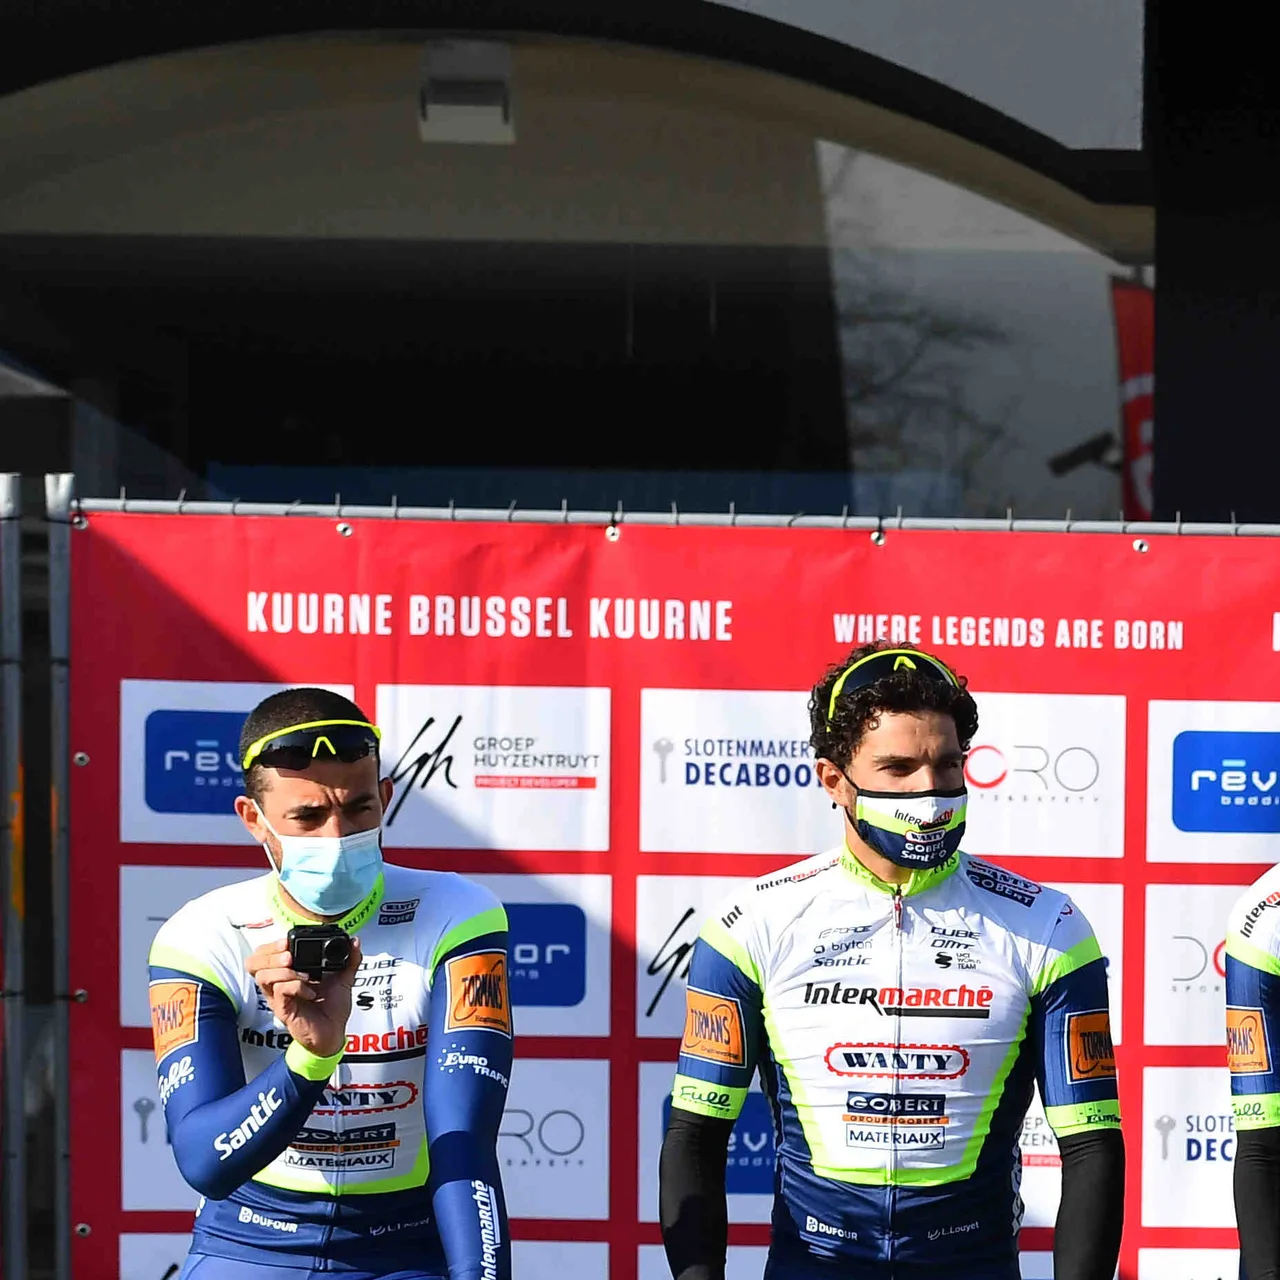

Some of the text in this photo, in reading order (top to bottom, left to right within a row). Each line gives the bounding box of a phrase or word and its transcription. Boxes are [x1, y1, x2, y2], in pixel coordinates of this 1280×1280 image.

[247, 592, 733, 642] KUURNE BRUSSEL KUURNE
[833, 613, 1184, 650] WHERE LEGENDS ARE BORN
[473, 737, 535, 751] GROEP
[685, 738, 810, 758] SLOTENMAKER
[474, 754, 600, 768] HUYZENTRUYT
[685, 761, 820, 787] DECABOO
[968, 873, 1032, 905] GOBERT
[931, 926, 981, 940] CUBE
[832, 939, 873, 952] bryton
[812, 955, 873, 968] Santic
[804, 981, 994, 1016] Intermarché
[690, 1009, 731, 1046] TORMANS
[443, 1052, 489, 1067] EURO
[842, 1052, 953, 1071] WANTY
[848, 1096, 941, 1112] GOBERT
[212, 1087, 283, 1161] Santic
[849, 1129, 942, 1145] MATERIAUX
[287, 1152, 391, 1169] MATERIAUX
[252, 1213, 298, 1234] DUFOUR
[818, 1222, 858, 1241] DUFOUR
